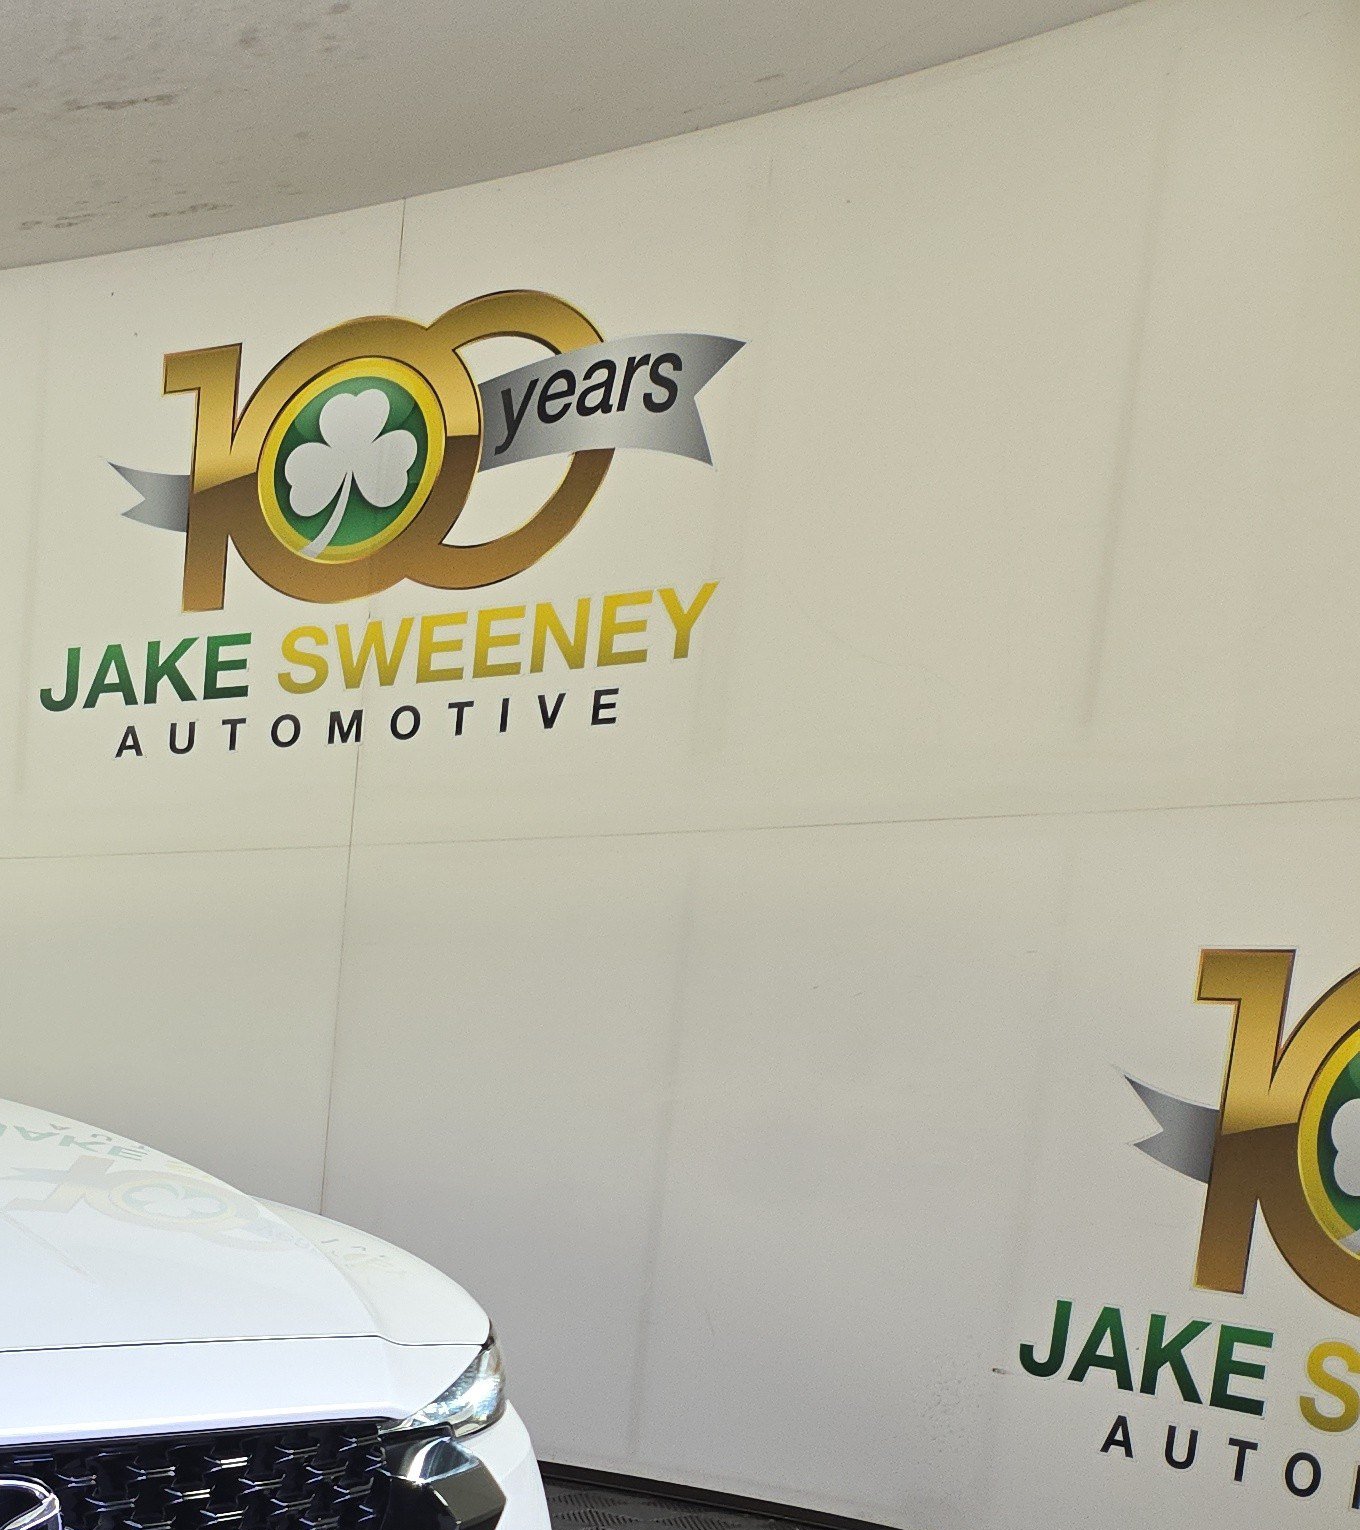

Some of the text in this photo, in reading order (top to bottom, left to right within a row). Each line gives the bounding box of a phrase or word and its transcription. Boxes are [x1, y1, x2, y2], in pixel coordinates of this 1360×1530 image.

[163, 290, 683, 613] 100 years
[40, 582, 720, 712] JAKE SWEENEY
[116, 688, 620, 758] AUTOMOTIVE
[1019, 1299, 1274, 1417] JAKE
[1100, 1415, 1360, 1510] AUTO
